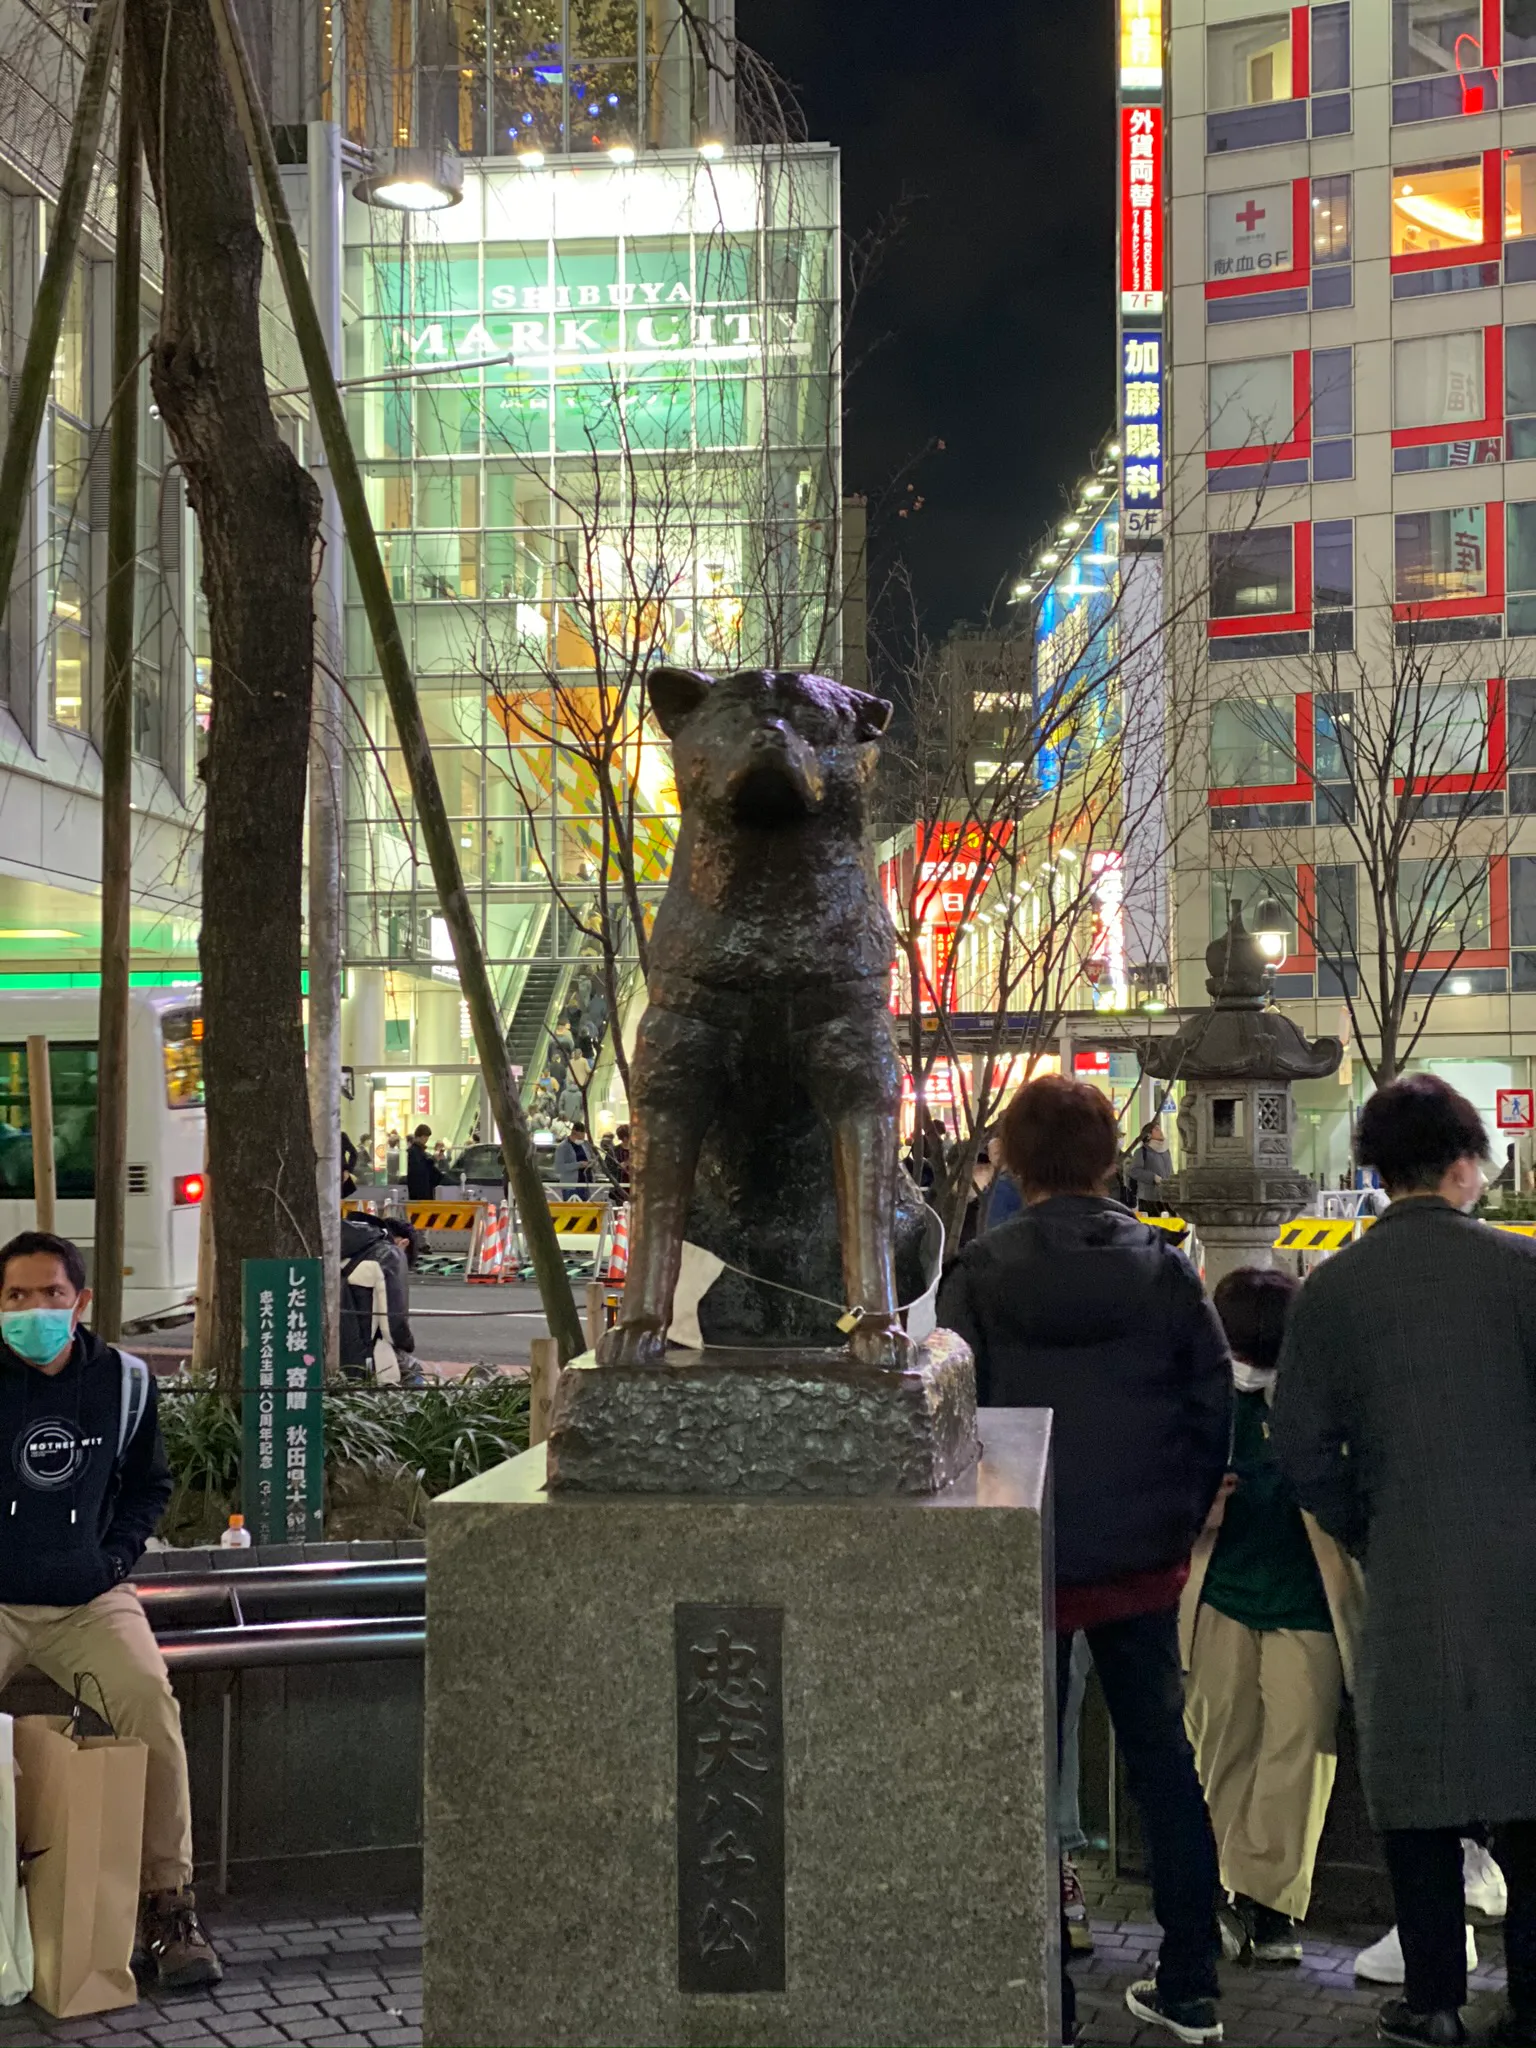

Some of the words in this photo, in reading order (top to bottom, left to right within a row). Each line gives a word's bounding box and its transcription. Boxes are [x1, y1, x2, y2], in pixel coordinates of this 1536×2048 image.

[1129, 109, 1154, 208] 外貨両替
[491, 281, 693, 309] SHIBUYA
[1131, 293, 1154, 308] 7F
[391, 319, 602, 356] MARK
[636, 310, 806, 348] CITY
[1125, 339, 1160, 500] 加藤眼科
[1129, 513, 1157, 531] 5F
[286, 1267, 308, 1351] しだれ桜
[81, 1437, 103, 1447] WIT
[687, 1627, 768, 1959] 忠犬ハチ公
